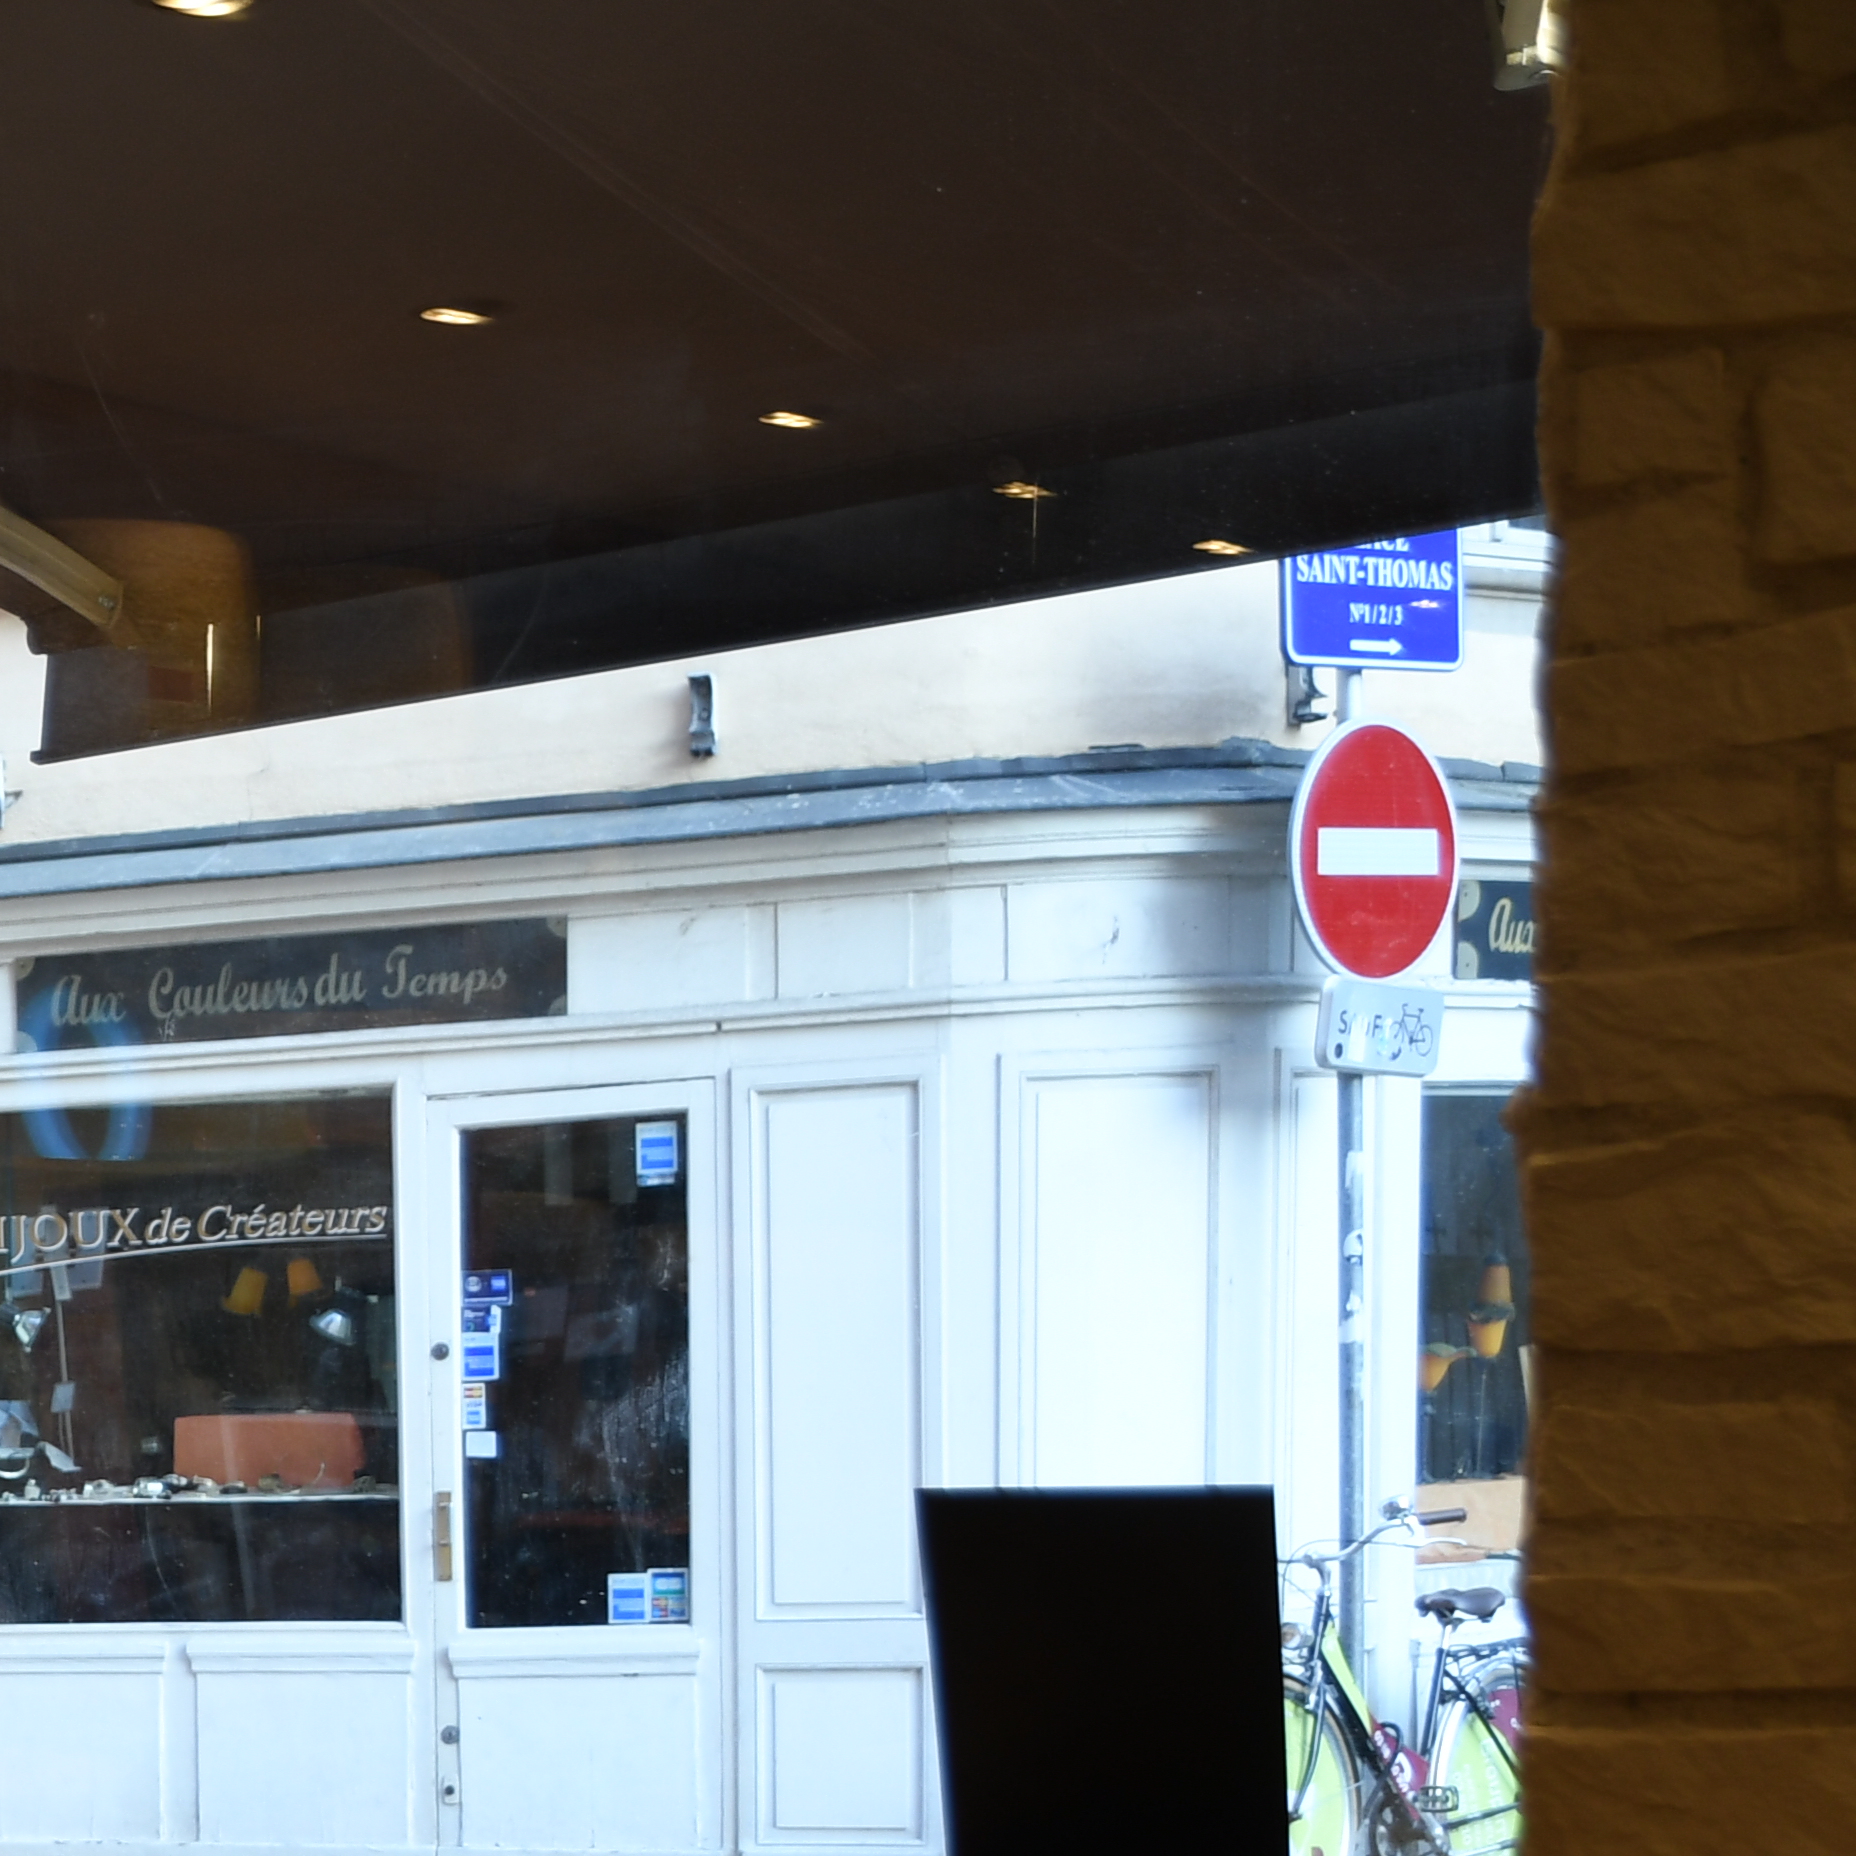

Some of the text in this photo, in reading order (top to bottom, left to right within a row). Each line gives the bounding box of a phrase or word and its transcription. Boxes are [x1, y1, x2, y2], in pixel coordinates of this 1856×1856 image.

[1296, 553, 1454, 591] SAINT-THOMAS
[50, 944, 508, 1027] Aux Couleurs du Temps
[145, 1207, 192, 1246] de
[197, 1204, 388, 1243] Créateurs
